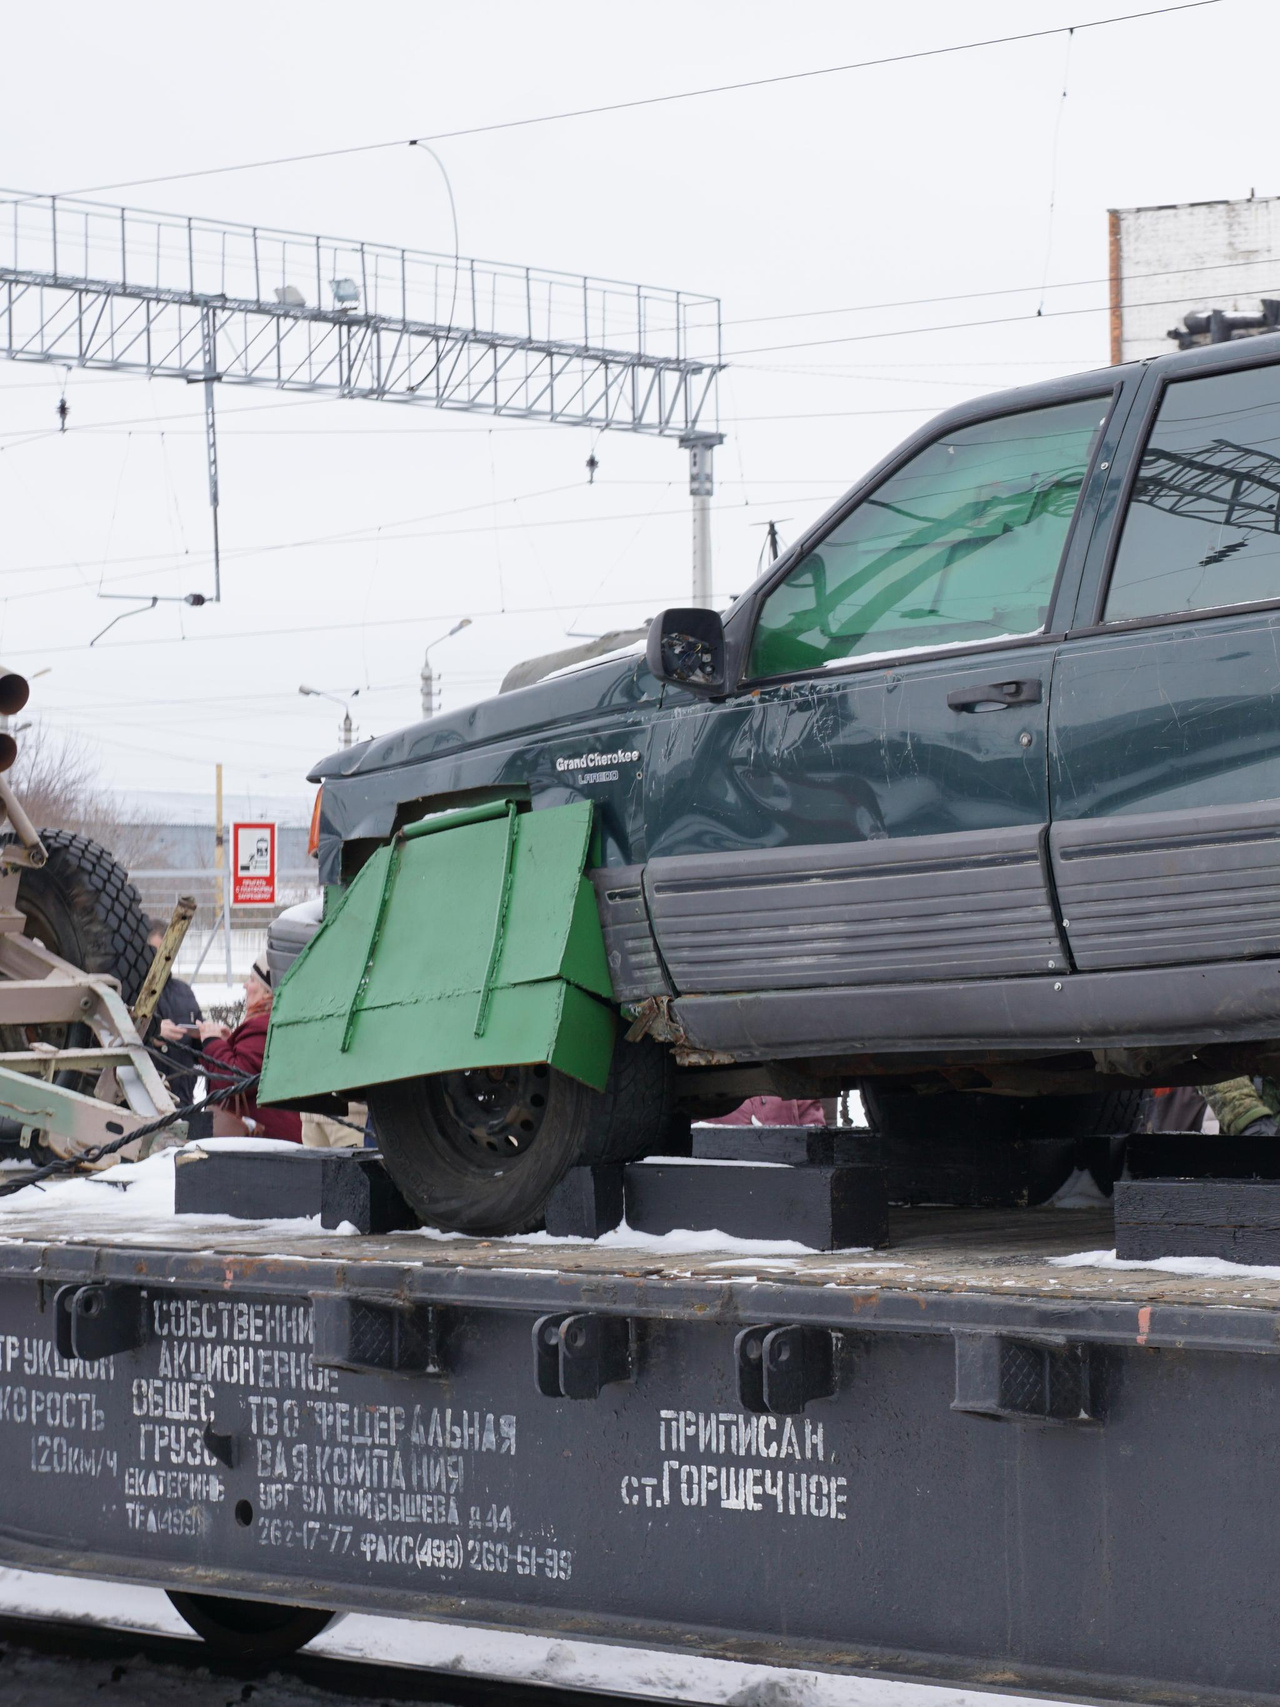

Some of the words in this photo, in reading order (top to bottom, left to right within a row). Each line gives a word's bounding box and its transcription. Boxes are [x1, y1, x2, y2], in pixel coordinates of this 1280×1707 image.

[578, 769, 619, 785] LAREDO
[158, 1339, 339, 1394] АКЦИОНЕРНОЕ
[659, 1409, 825, 1461] ПРИПИСАН
